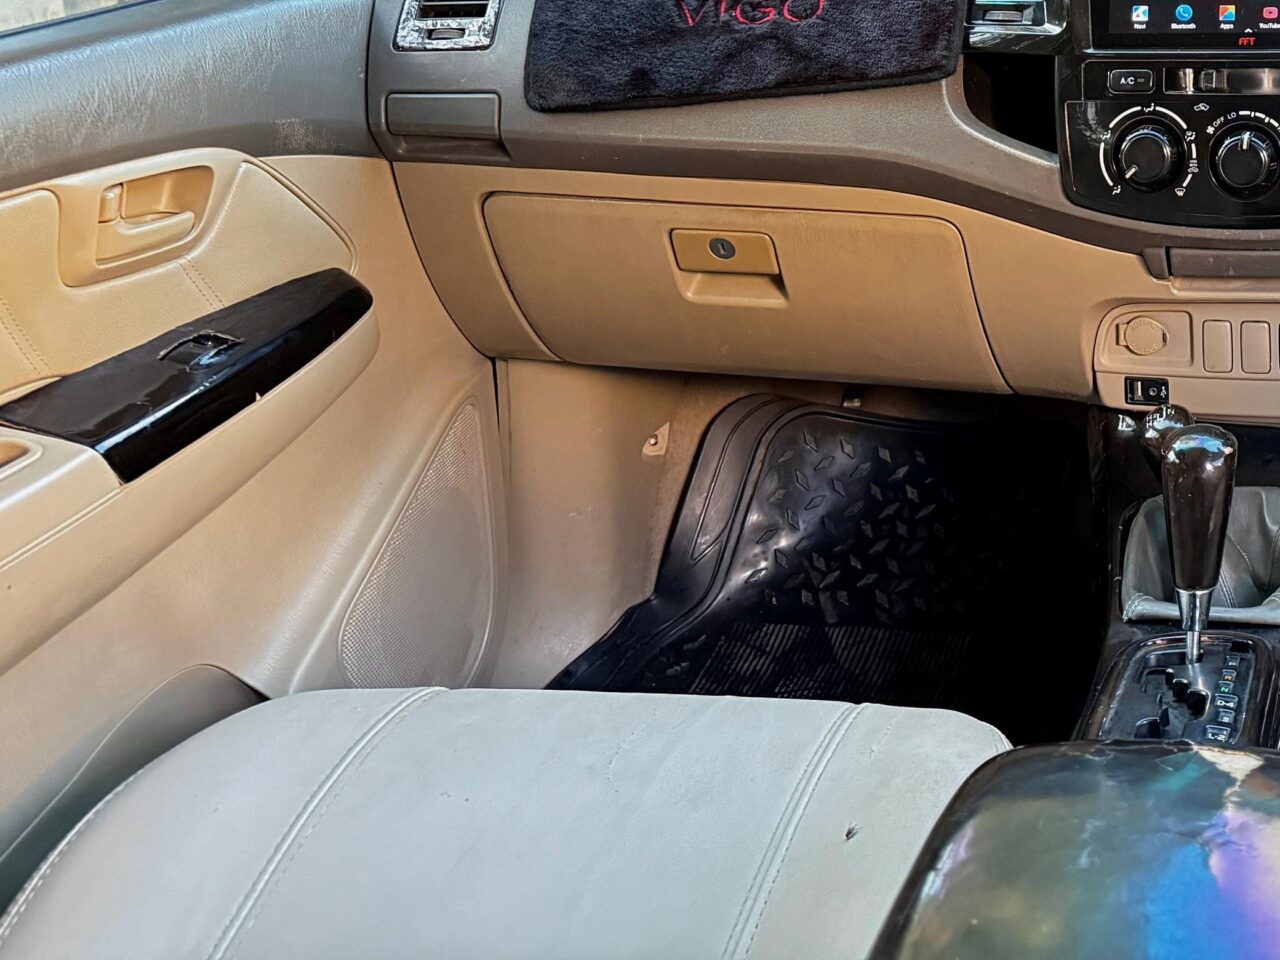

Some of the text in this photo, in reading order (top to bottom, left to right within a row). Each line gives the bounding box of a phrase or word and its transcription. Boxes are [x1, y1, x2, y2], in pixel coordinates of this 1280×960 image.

[1120, 76, 1135, 85] A/C
[1212, 111, 1237, 127] OFF LO
